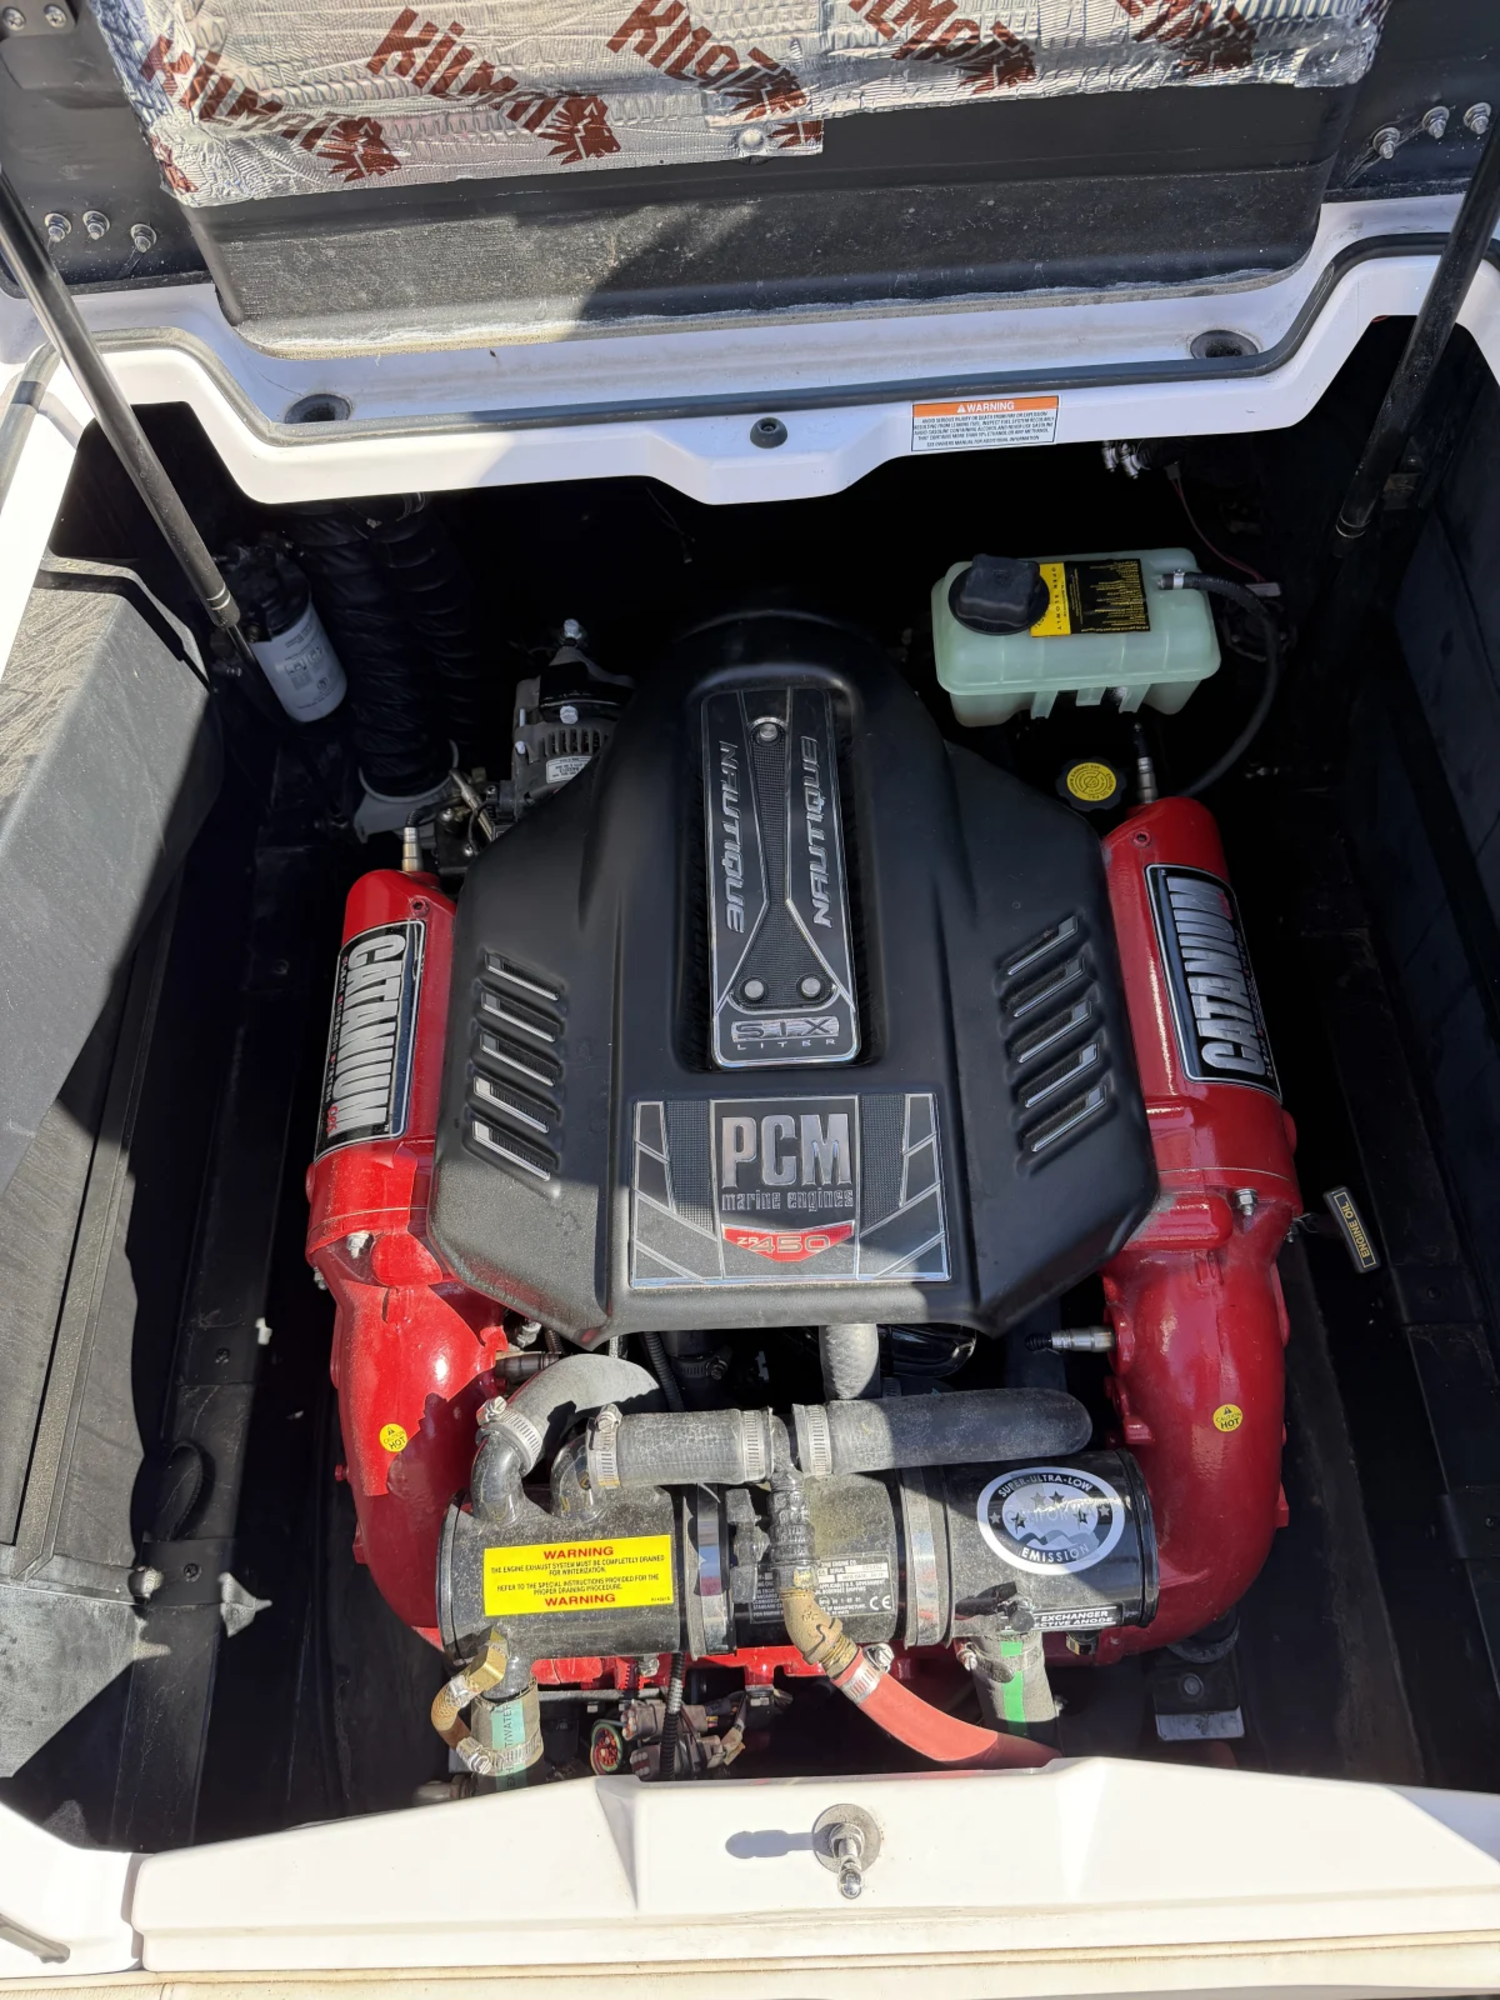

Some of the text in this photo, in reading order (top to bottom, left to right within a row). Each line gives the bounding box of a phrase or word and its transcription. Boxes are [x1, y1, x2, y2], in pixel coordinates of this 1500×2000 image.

[966, 401, 1014, 412] WARNING
[719, 741, 745, 933] NAUTIQUE
[800, 736, 833, 928] NAUTIQUE
[1166, 876, 1266, 1075] CATANIUM
[328, 934, 406, 1138] CATANIUM
[734, 1019, 833, 1040] SIX
[736, 1038, 836, 1051] LITER
[721, 1113, 852, 1188] PCM
[721, 1189, 854, 1212] marine engines
[1338, 1201, 1370, 1258] ENGINE OIL
[1221, 1417, 1239, 1429] HOT
[389, 1436, 406, 1449] HOT
[543, 1546, 613, 1559] WARNING
[1021, 1543, 1090, 1562] EMISSION
[602, 1556, 638, 1565] COMPLETELY
[563, 1578, 603, 1586] INSTRUCTIONS
[605, 1575, 634, 1583] PROVIDED
[533, 1587, 556, 1595] PROPER
[558, 1585, 585, 1593] DRAINING
[544, 1593, 615, 1606] WARNING
[869, 1595, 892, 1611] CE
[1041, 1610, 1108, 1622] EXCHANGER
[1073, 1616, 1114, 1625] ANODE
[503, 1704, 515, 1787] EXHT/WATER
